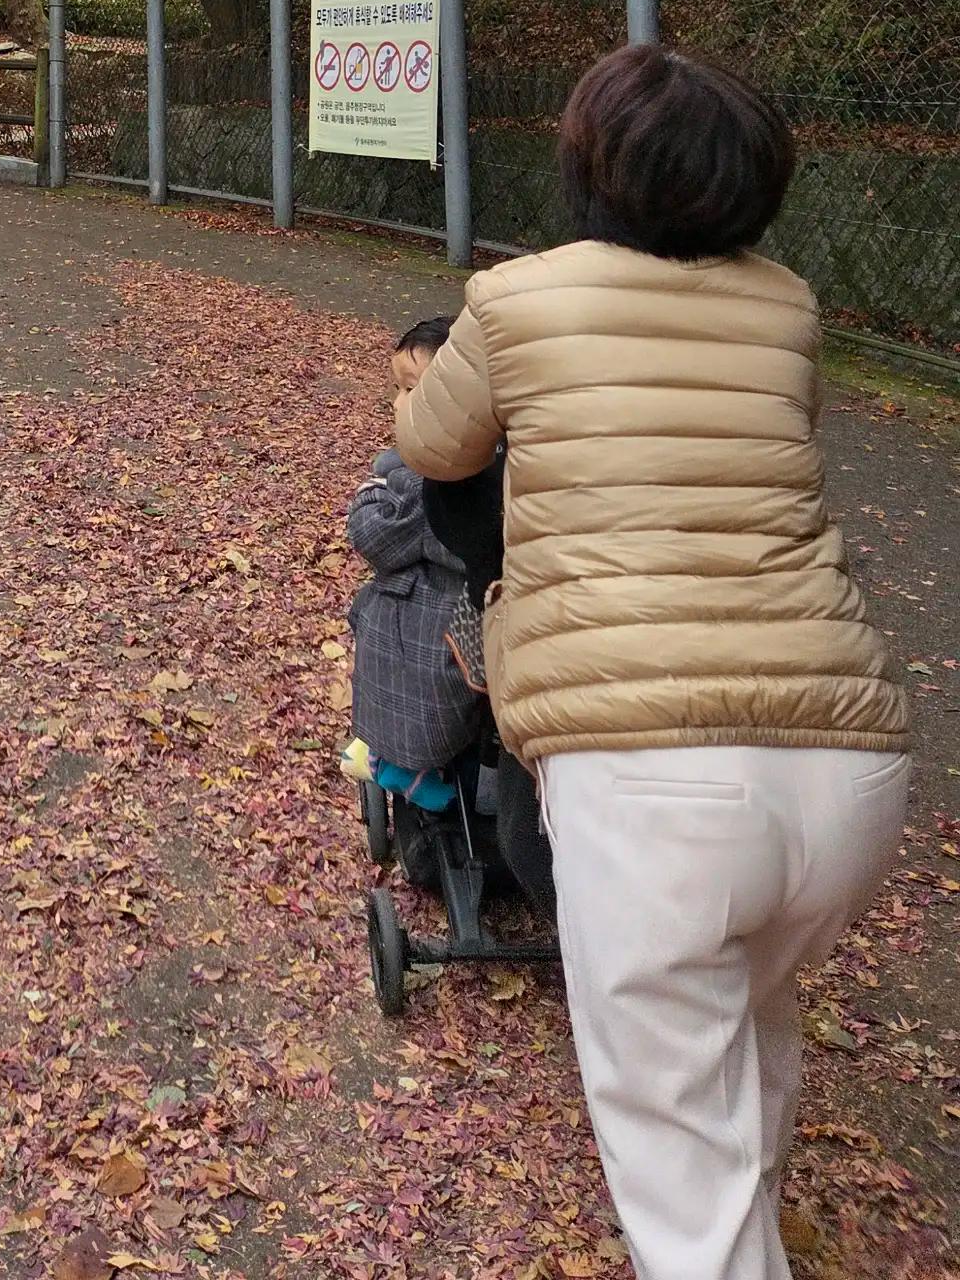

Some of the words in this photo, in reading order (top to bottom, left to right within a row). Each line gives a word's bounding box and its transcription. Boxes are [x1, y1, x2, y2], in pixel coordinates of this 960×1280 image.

[315, 7, 332, 27] 모두가
[333, 6, 354, 27] 편안하게
[355, 5, 372, 26] 휴식할
[372, 5, 379, 26] 수
[380, 4, 397, 24] 있도록
[399, 1, 433, 24] 배려해주세요
